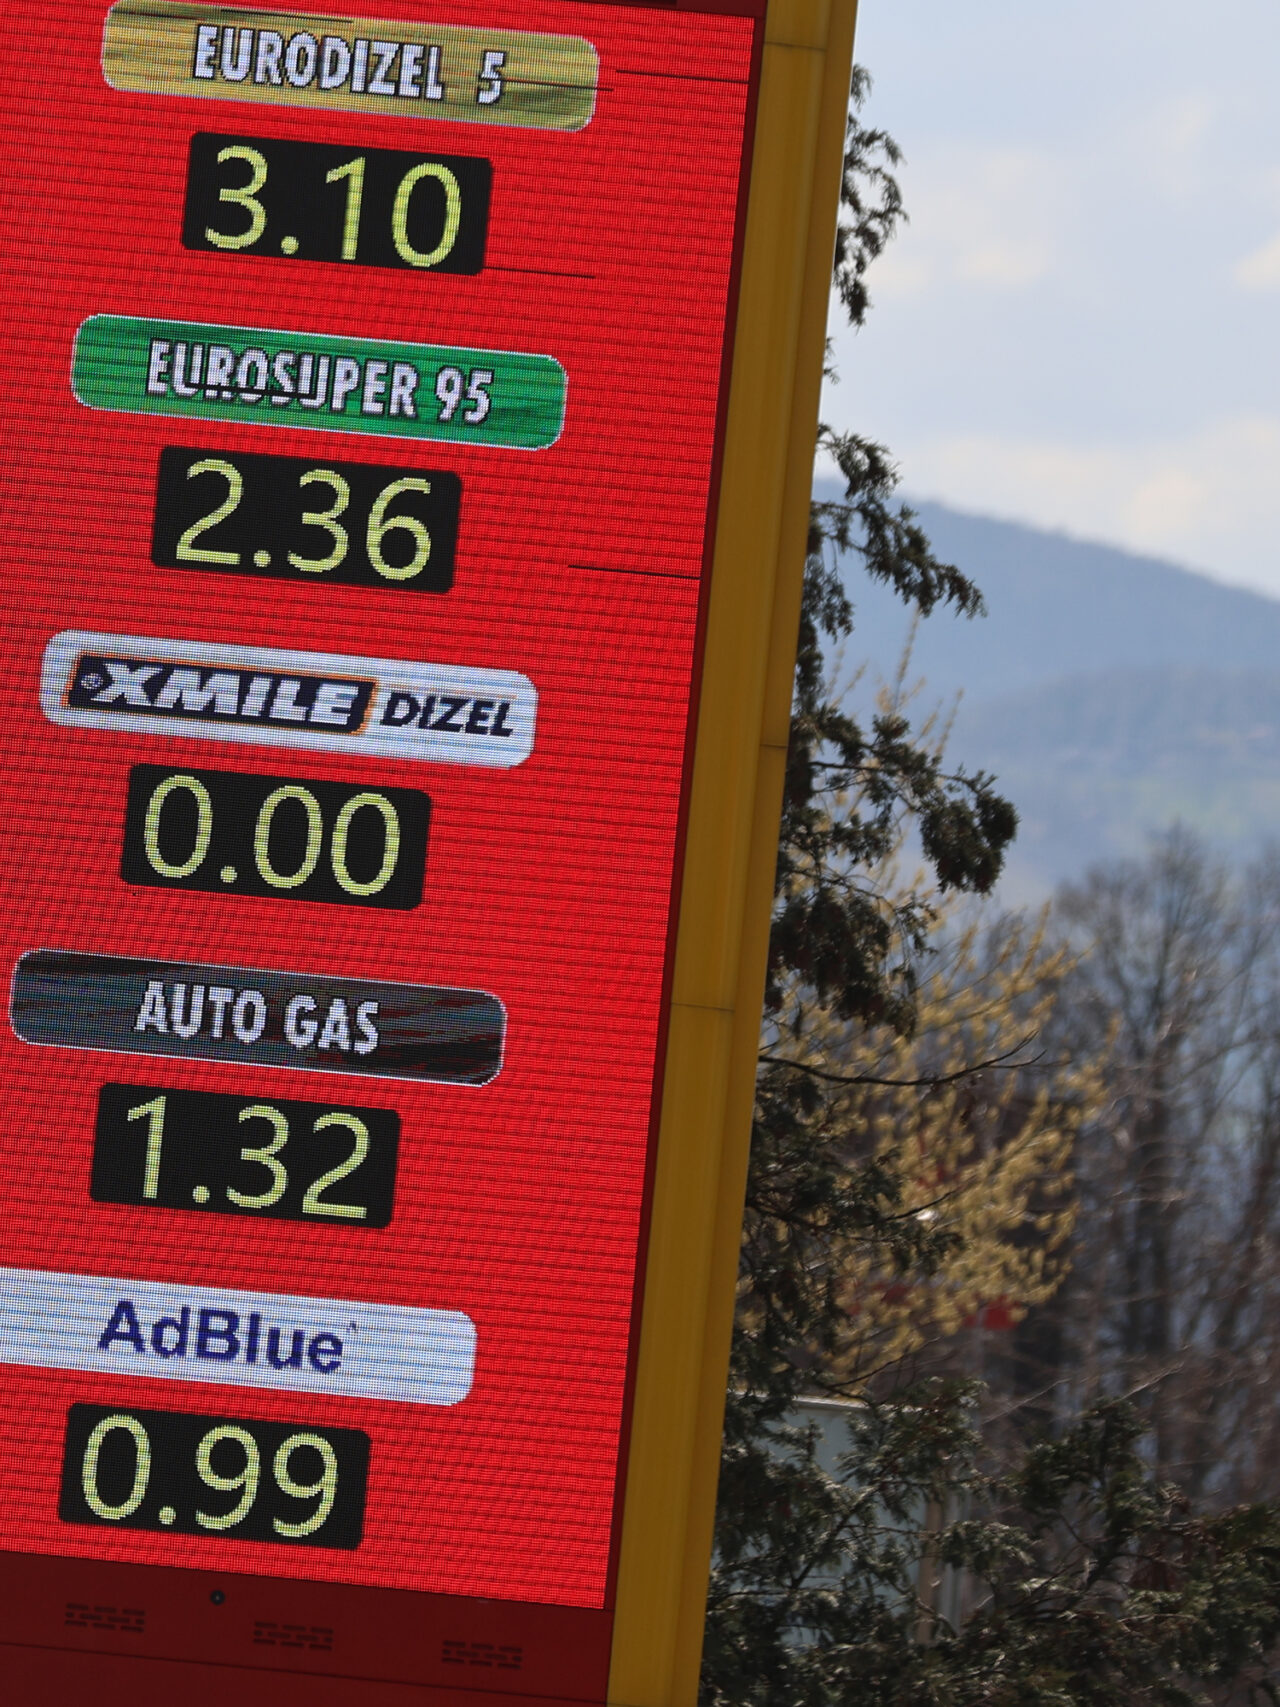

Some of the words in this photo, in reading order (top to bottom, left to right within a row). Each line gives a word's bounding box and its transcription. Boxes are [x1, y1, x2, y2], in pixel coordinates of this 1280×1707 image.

[194, 24, 445, 101] EURODIZEL
[477, 51, 507, 104] 5
[204, 145, 462, 268] 3.10
[147, 338, 417, 418] EUROSUPER
[434, 367, 494, 425] 95
[175, 458, 432, 581] 2.36
[91, 661, 360, 726] XMILE
[380, 691, 514, 738] DIZEL
[143, 774, 401, 896] 0.00
[134, 980, 267, 1044] AUTO
[284, 993, 380, 1056] GAS
[126, 1095, 370, 1219] 1.32
[97, 1300, 344, 1374] AdBlue
[81, 1414, 339, 1538] 0.99
